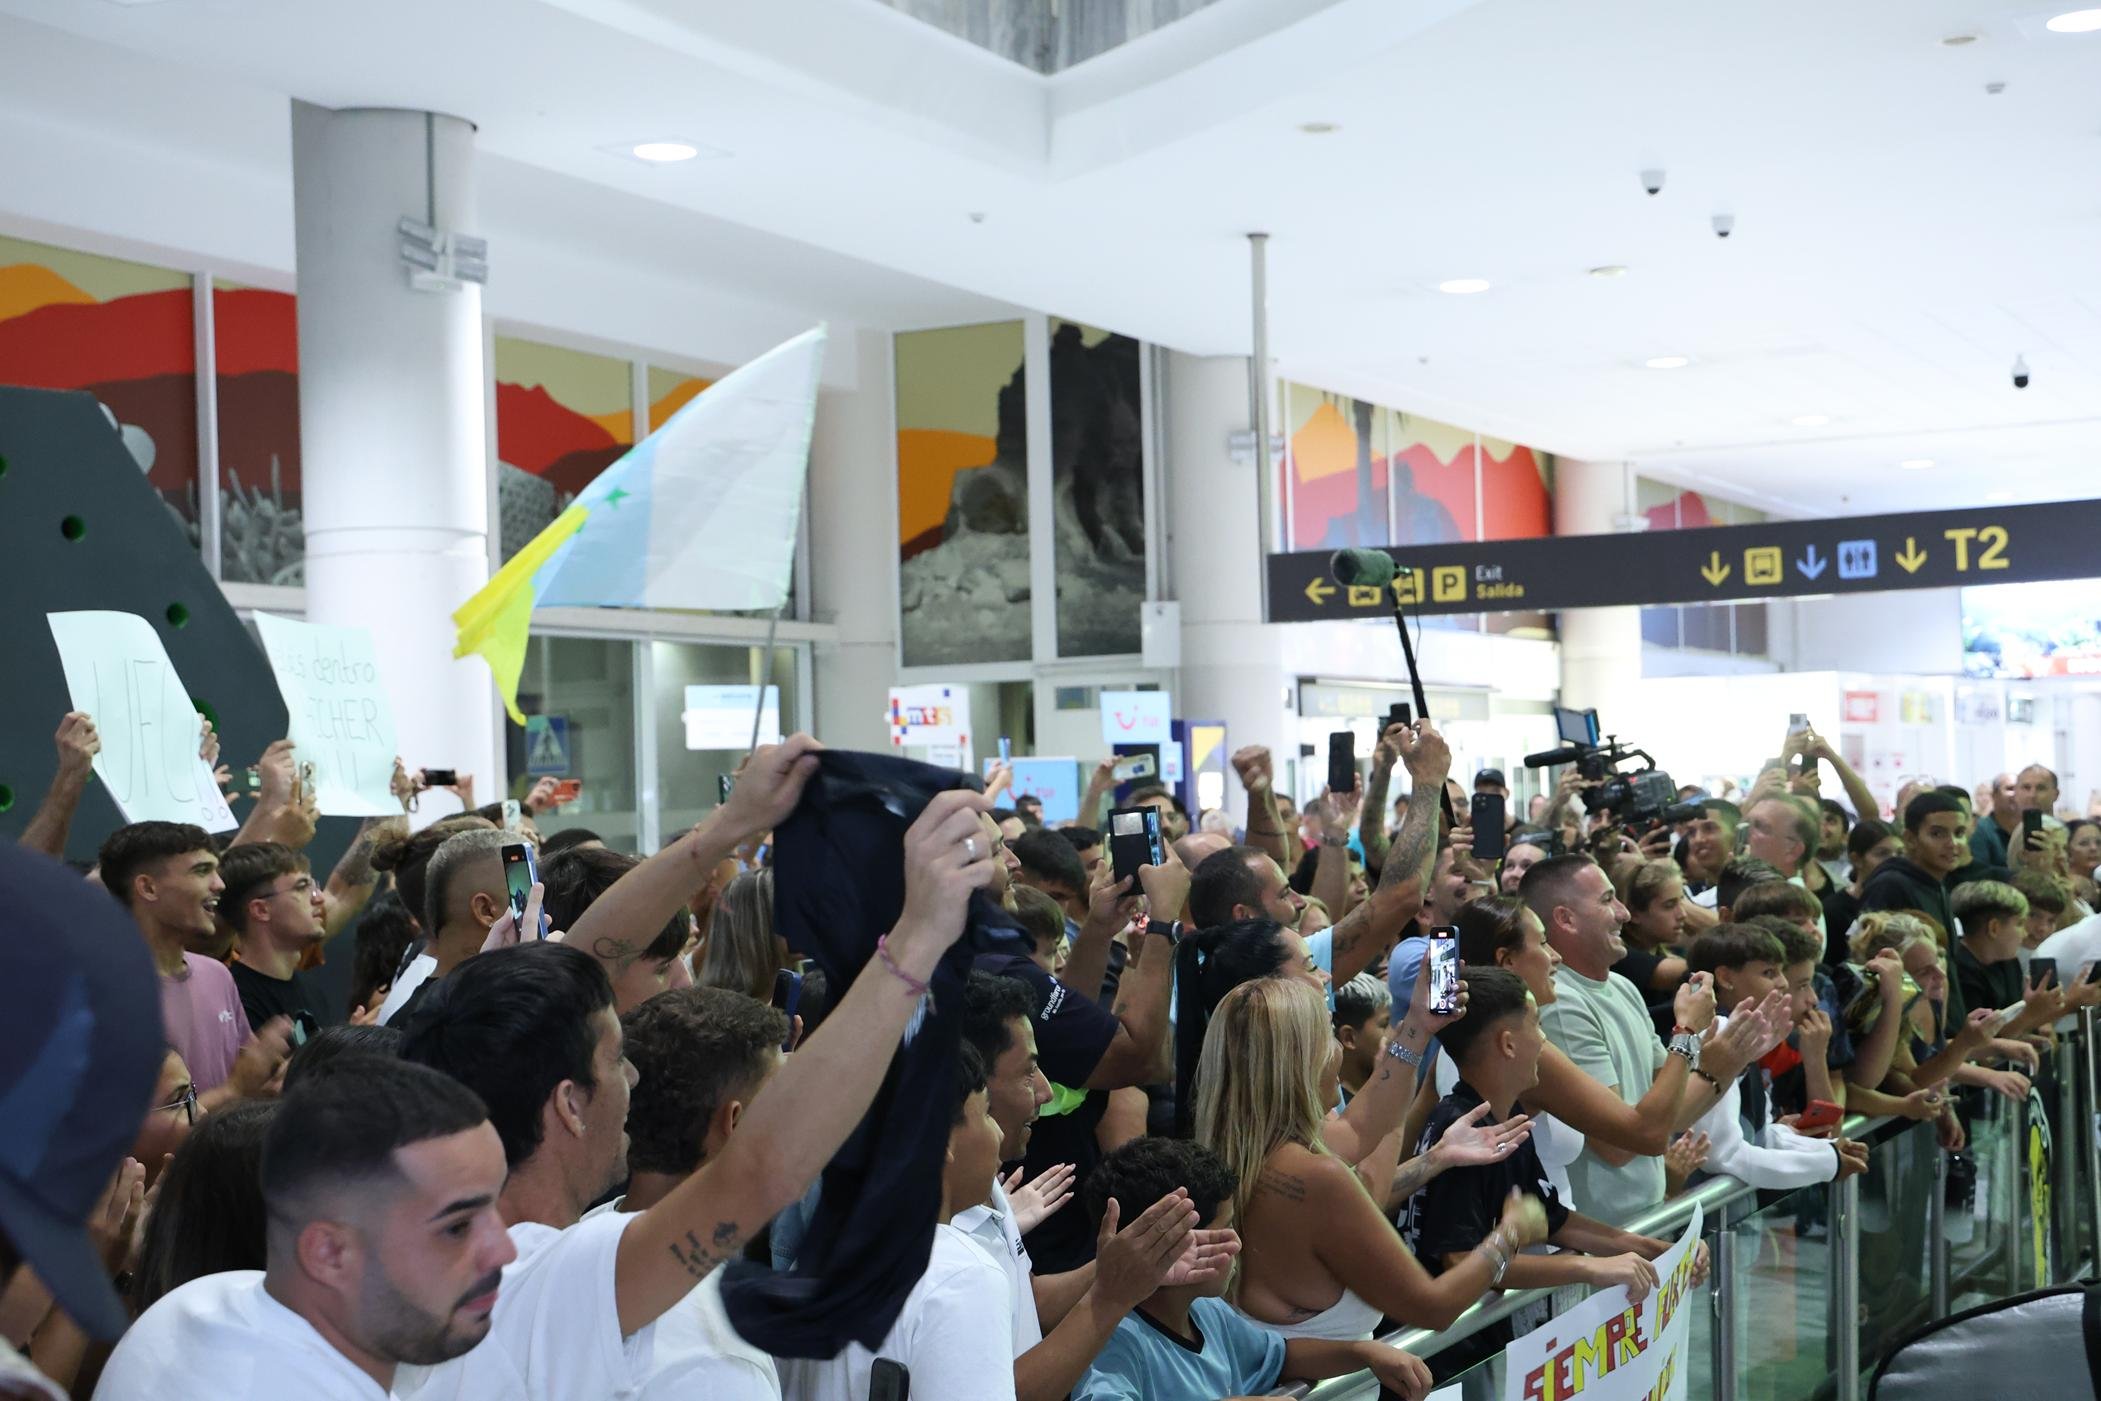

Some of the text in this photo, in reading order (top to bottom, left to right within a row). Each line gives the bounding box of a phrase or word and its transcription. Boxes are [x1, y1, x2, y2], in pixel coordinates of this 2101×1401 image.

[1944, 525, 2010, 572] T2
[1475, 565, 1503, 581] Exit
[1476, 582, 1525, 600] Salida
